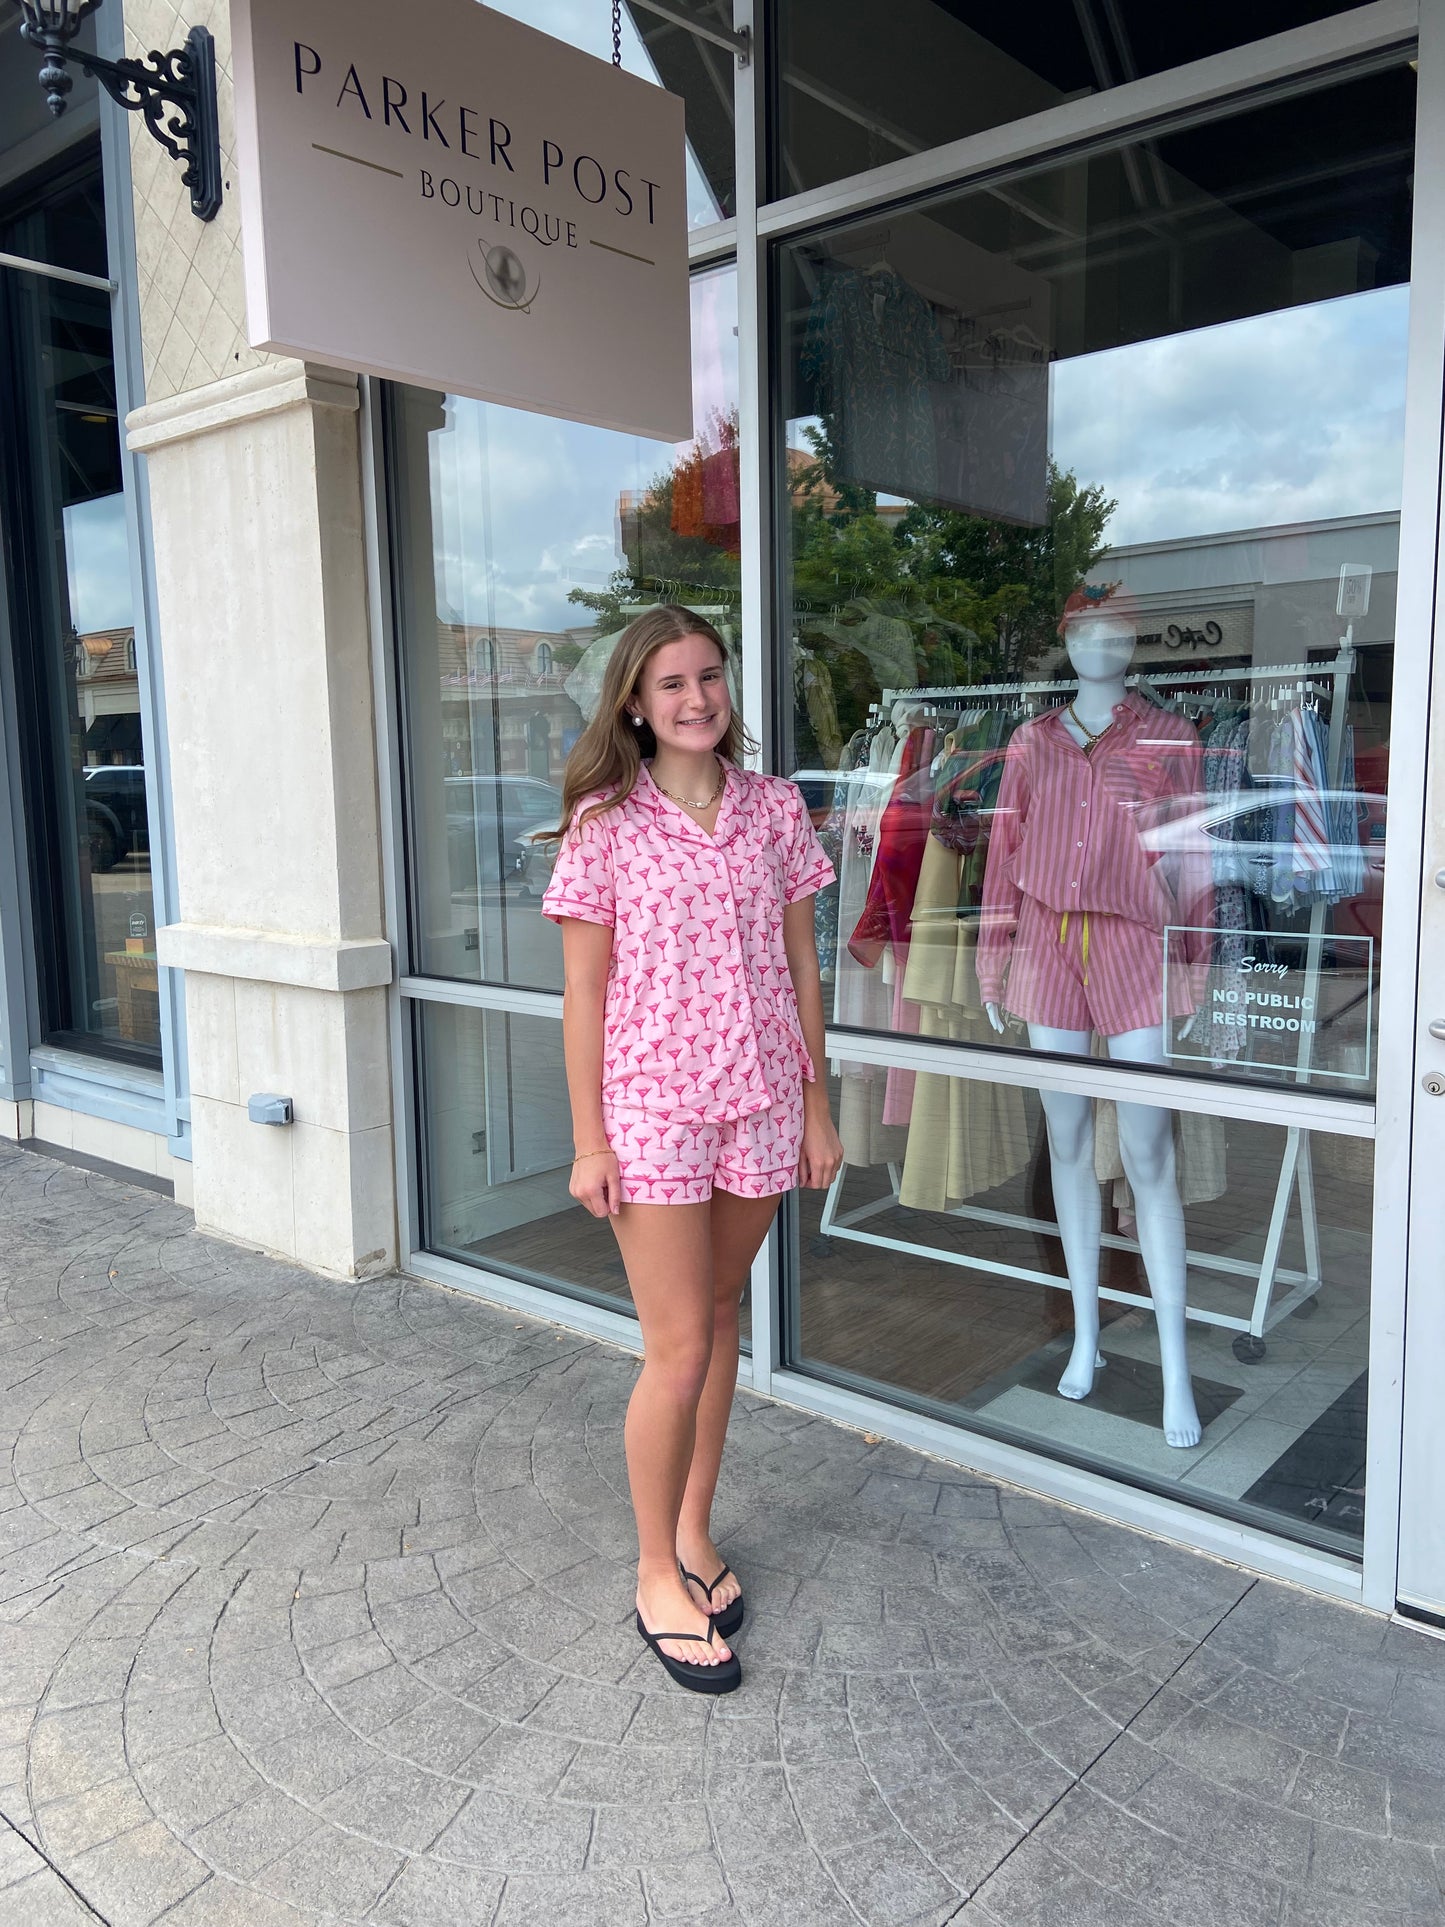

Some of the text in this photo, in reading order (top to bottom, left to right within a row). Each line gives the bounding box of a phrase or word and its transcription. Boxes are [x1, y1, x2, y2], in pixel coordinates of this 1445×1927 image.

[293, 41, 661, 225] PARKER POST
[419, 169, 579, 249] BOUTIQUE
[1238, 956, 1288, 979] Sorry
[1213, 989, 1314, 1010] NO PUBLIC
[1213, 1012, 1316, 1033] RESTROOM
